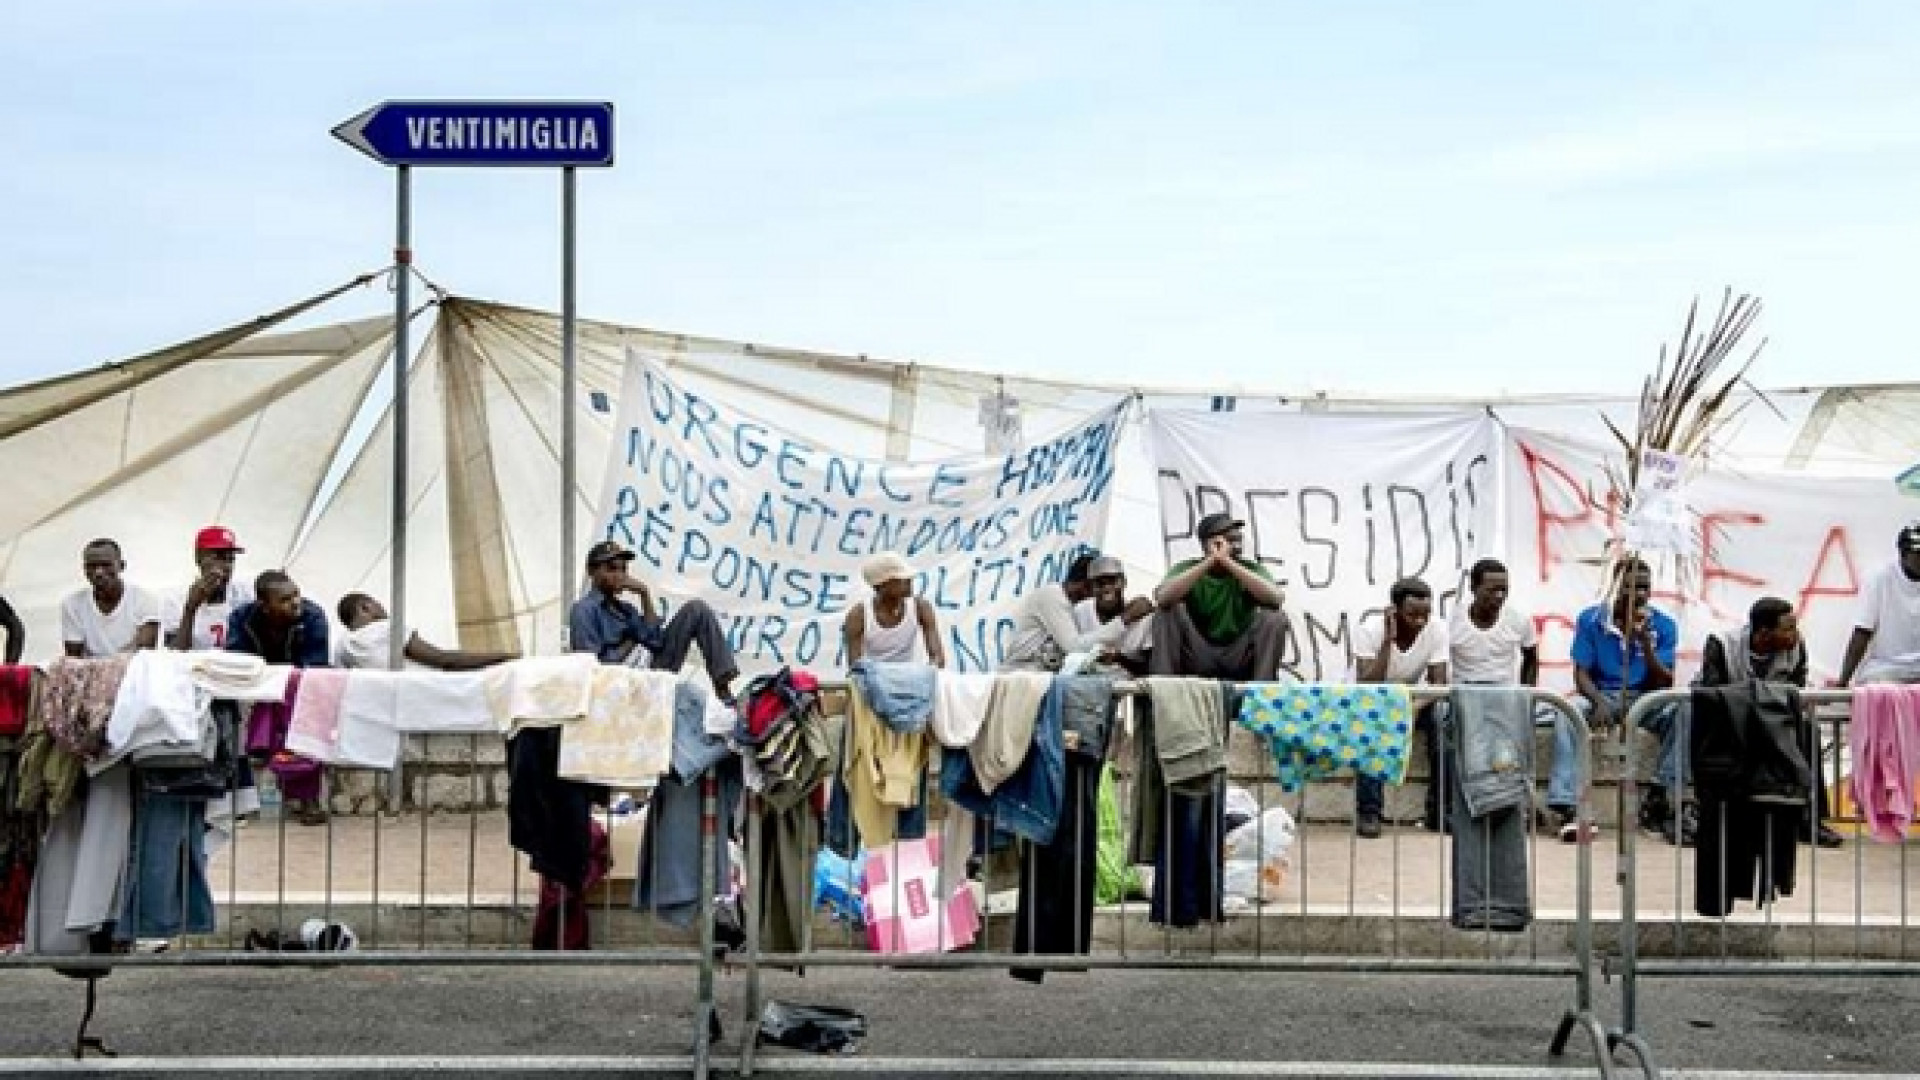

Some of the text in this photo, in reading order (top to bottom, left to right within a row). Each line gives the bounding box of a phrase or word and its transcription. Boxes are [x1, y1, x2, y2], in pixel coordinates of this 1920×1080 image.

[406, 116, 600, 150] VENTIMIGLIA
[627, 426, 732, 526] NOUS
[751, 491, 1020, 558] ATTENDONS
[643, 370, 967, 508] URGENCE
[605, 485, 850, 614] RÉPONSE
[1157, 454, 1487, 590] PESIDI
